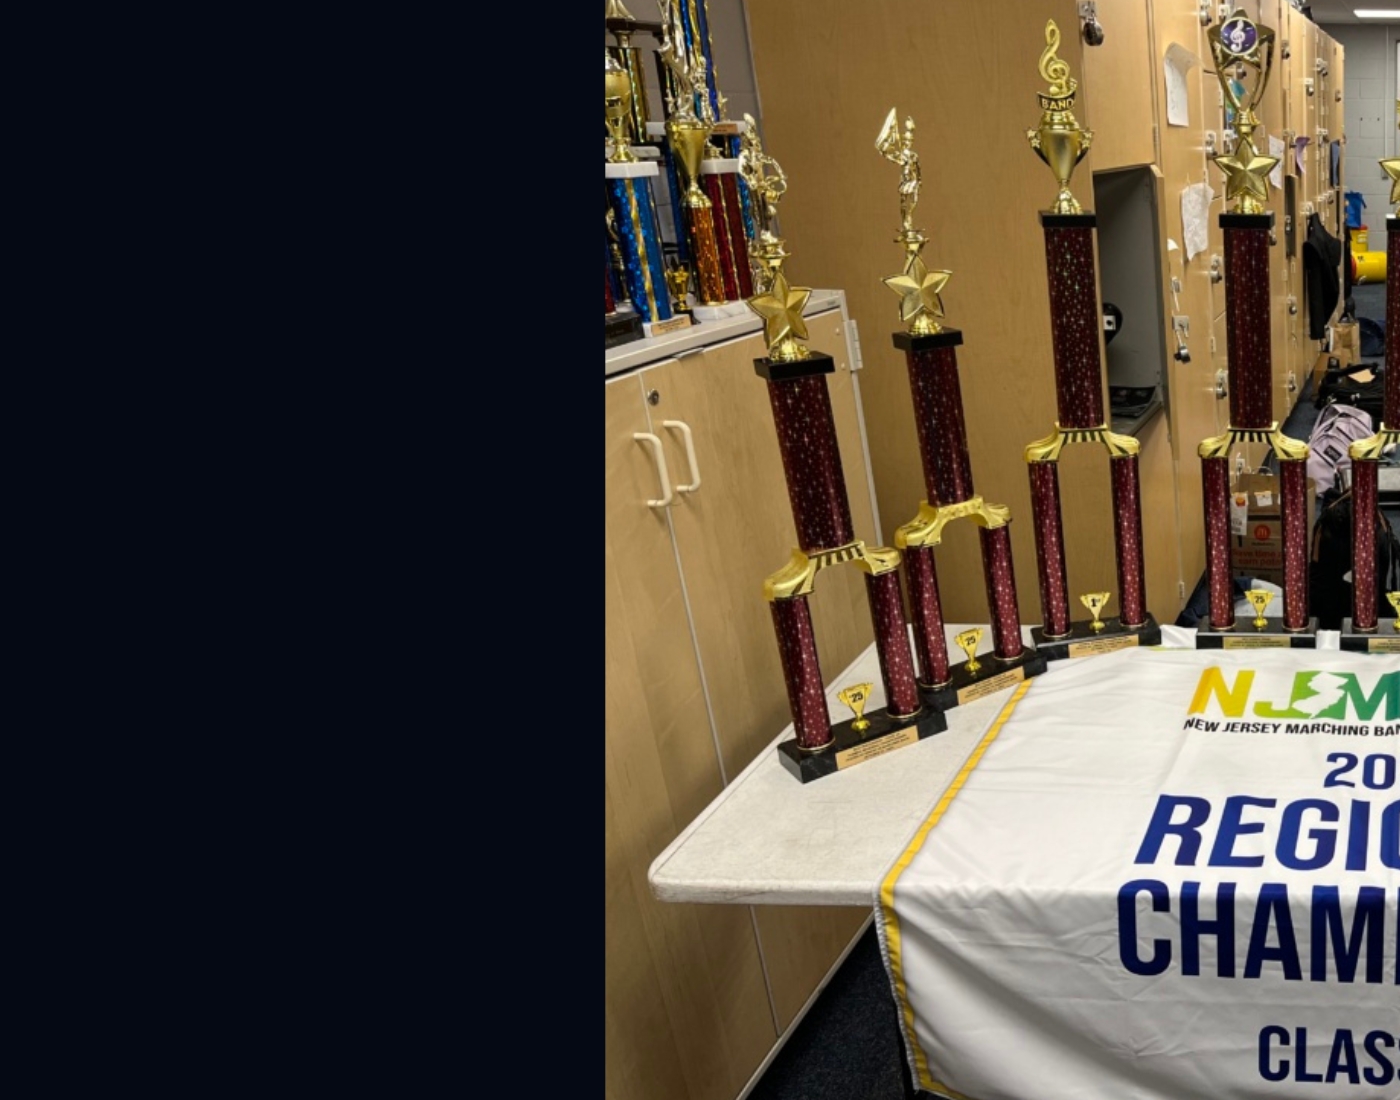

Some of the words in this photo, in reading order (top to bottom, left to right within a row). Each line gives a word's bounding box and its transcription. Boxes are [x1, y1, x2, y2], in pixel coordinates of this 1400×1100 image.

[1041, 97, 1075, 110] BAND
[1183, 717, 1220, 732] NEW
[1222, 722, 1281, 734] JERSEY
[1285, 722, 1369, 737] MARCHING
